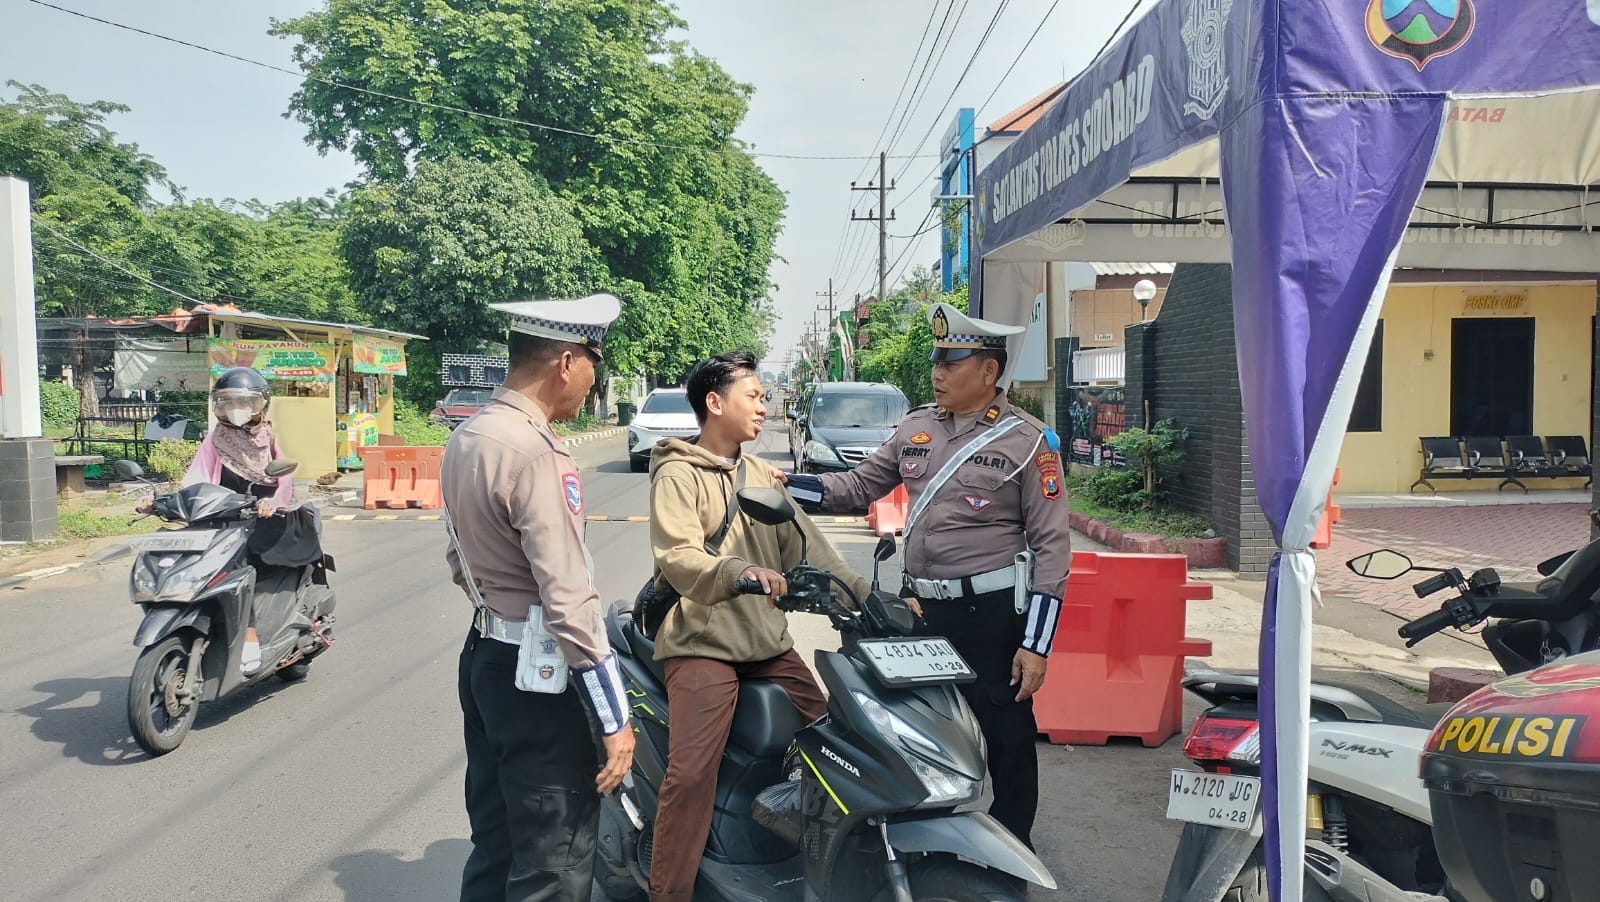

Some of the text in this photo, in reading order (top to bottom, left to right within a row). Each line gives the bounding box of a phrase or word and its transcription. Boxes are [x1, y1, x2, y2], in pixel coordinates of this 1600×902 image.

[992, 151, 1040, 224] SATLANTAS
[1039, 118, 1080, 196] POLRES
[901, 447, 930, 457] HERRY
[963, 454, 1006, 469] POLRI
[866, 646, 882, 659] L
[884, 644, 923, 657] 4834
[1438, 716, 1577, 757] POLISI
[820, 745, 861, 778] HONDA
[1191, 777, 1225, 797] 2120
